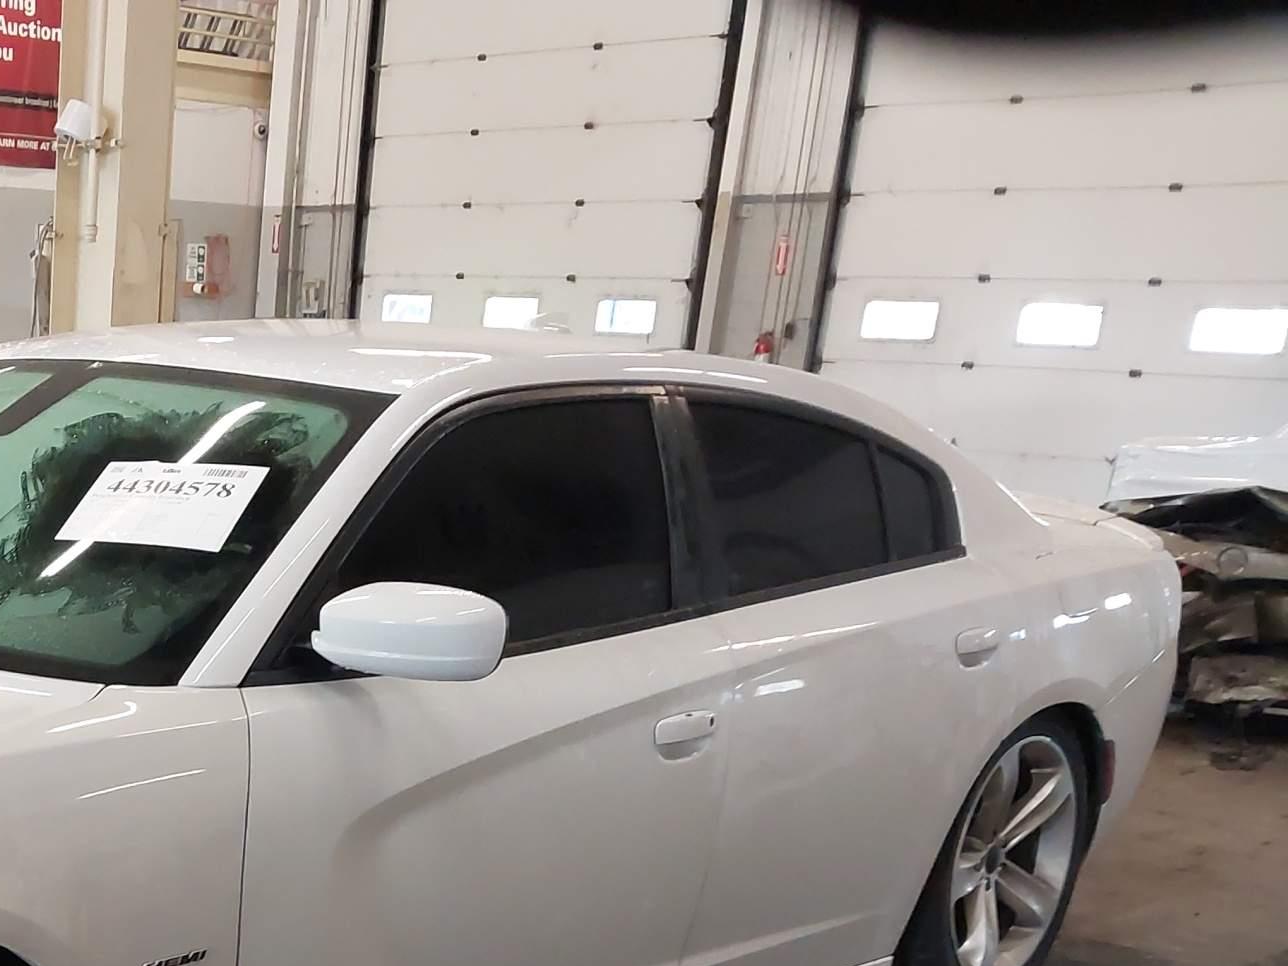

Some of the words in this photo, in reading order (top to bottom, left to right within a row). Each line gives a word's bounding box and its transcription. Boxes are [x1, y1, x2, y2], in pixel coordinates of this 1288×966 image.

[17, 139, 38, 150] MORE
[40, 142, 50, 151] AT
[107, 479, 236, 498] 44304578
